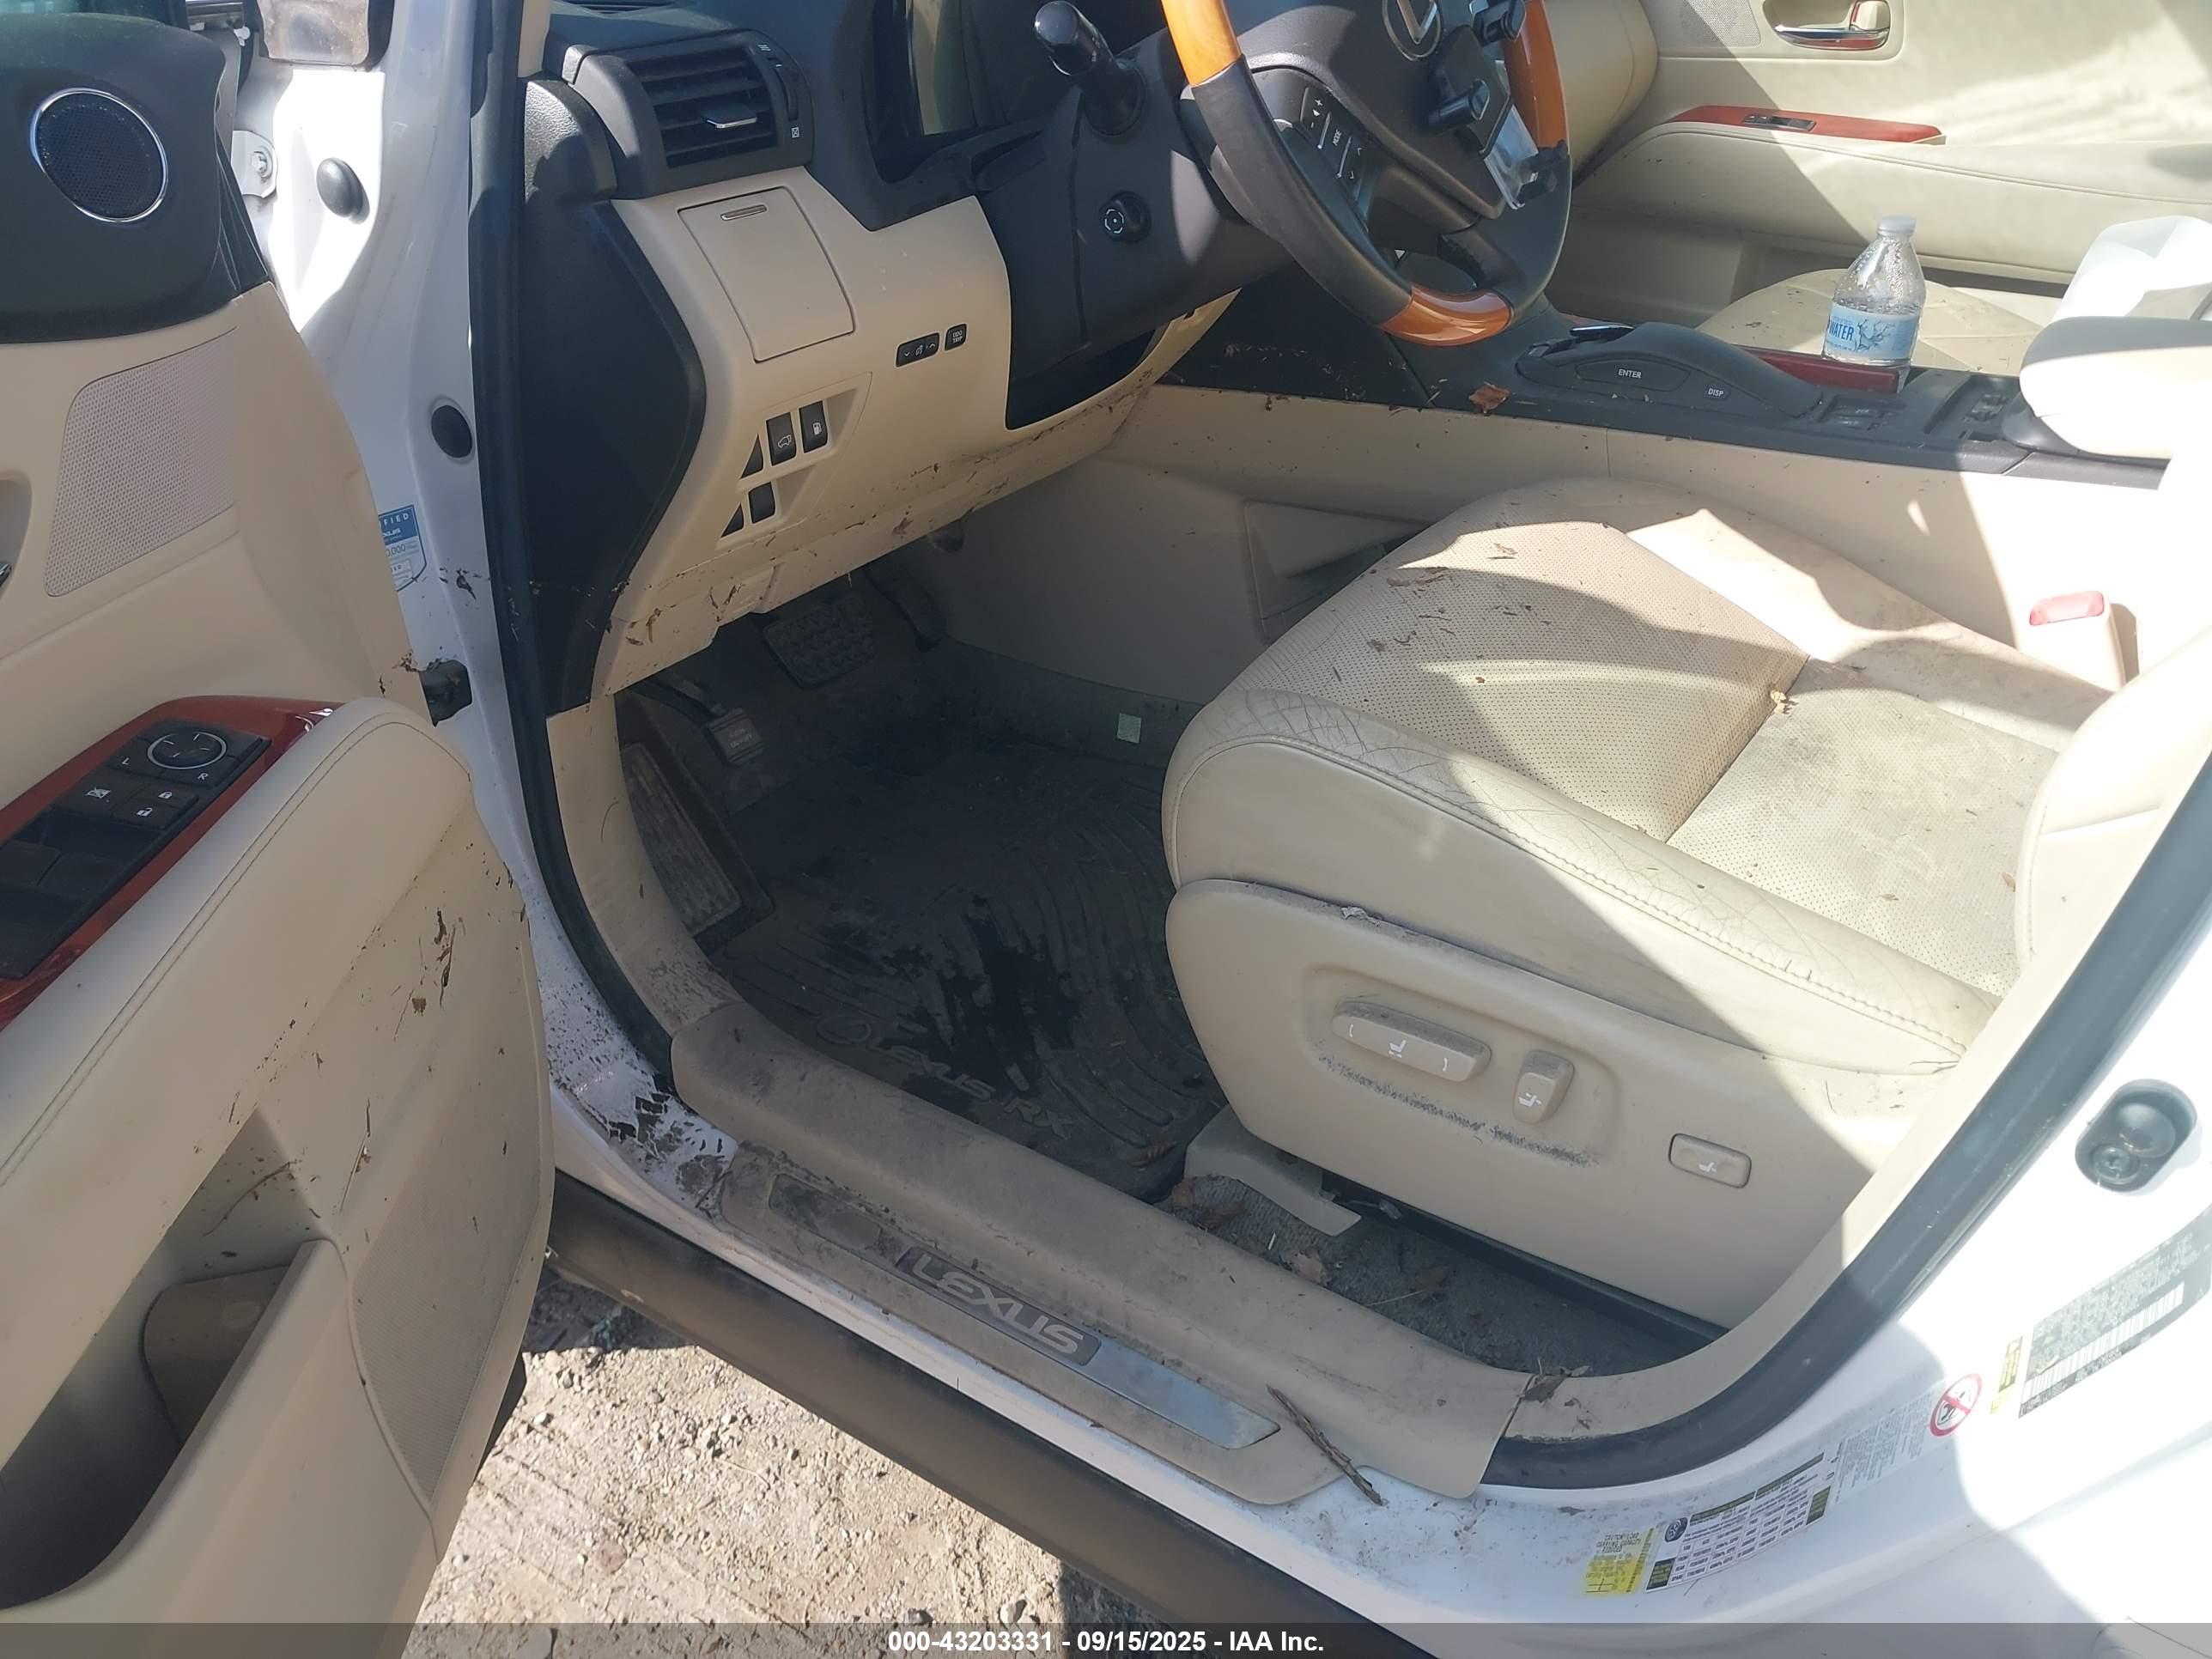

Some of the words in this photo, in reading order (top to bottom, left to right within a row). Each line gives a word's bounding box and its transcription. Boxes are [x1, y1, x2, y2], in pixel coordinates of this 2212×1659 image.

[1332, 129, 1341, 146] MODE
[1828, 319, 1855, 341] WATER
[1618, 368, 1642, 379] ENTER
[1708, 387, 1724, 397] DISP
[383, 513, 410, 526] FIED
[198, 772, 209, 781] R
[866, 1037, 996, 1101] LEXUS
[1003, 1097, 1073, 1140] RX
[912, 1253, 1084, 1354] LEXUS
